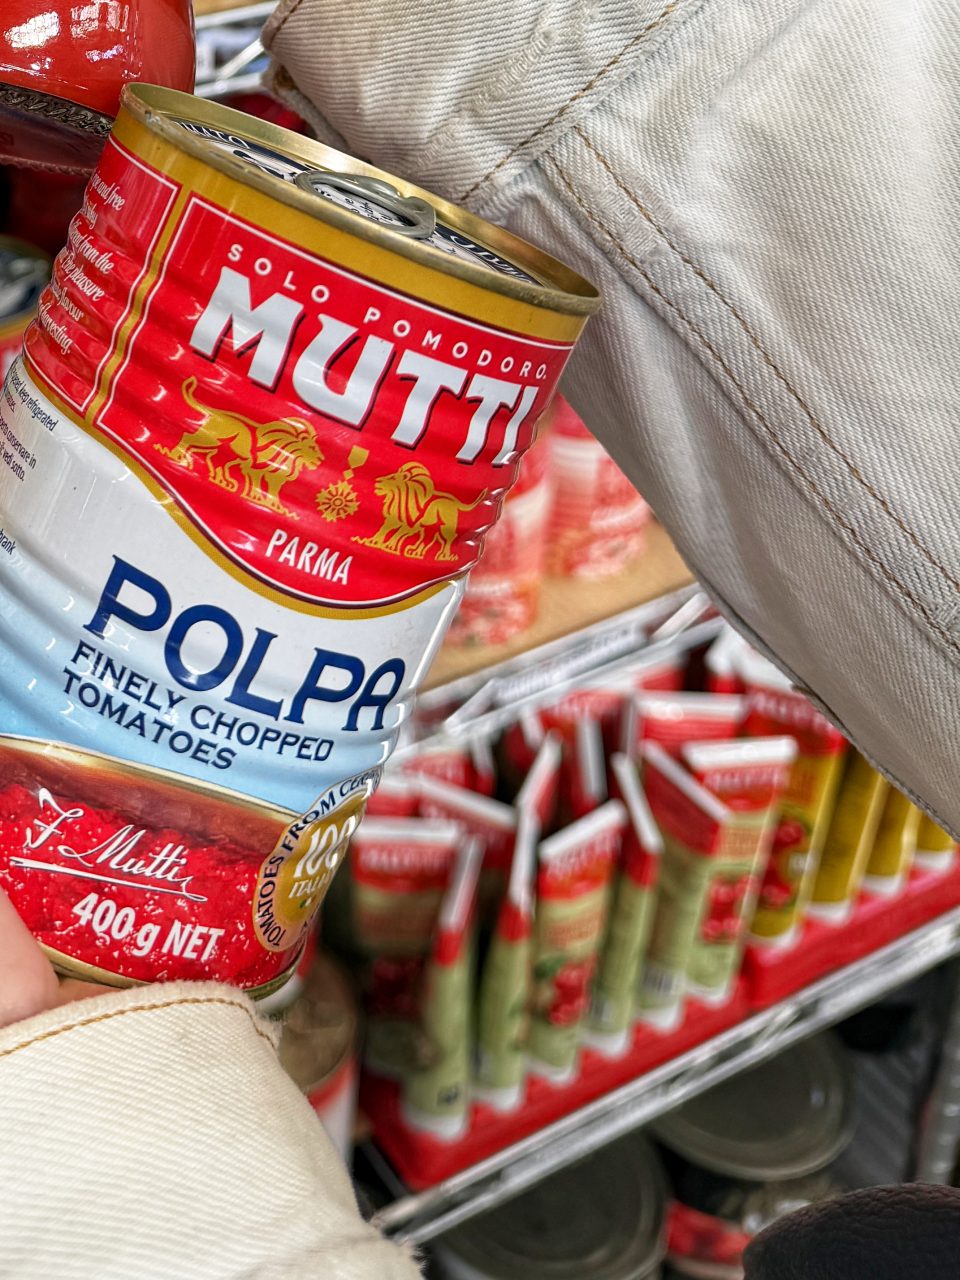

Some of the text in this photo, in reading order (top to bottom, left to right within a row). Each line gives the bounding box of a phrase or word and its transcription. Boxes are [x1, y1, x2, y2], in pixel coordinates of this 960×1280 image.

[103, 186, 126, 211] free
[63, 264, 105, 302] pleasure
[94, 251, 115, 275] the
[227, 244, 331, 304] SOLO
[189, 266, 539, 467] MUTTI
[26, 400, 59, 432] refrigerated
[6, 429, 31, 465] conservare
[28, 453, 37, 470] in
[10, 462, 25, 481] sotto.
[264, 528, 354, 586] PARMA
[83, 554, 406, 733] POLPA
[63, 666, 239, 770] TOMATOES
[70, 639, 335, 762] FINELY CHOPPED
[57, 824, 194, 883] Mutti
[257, 789, 337, 947] TOMATOES FROM
[72, 892, 226, 963] 400 g NET
